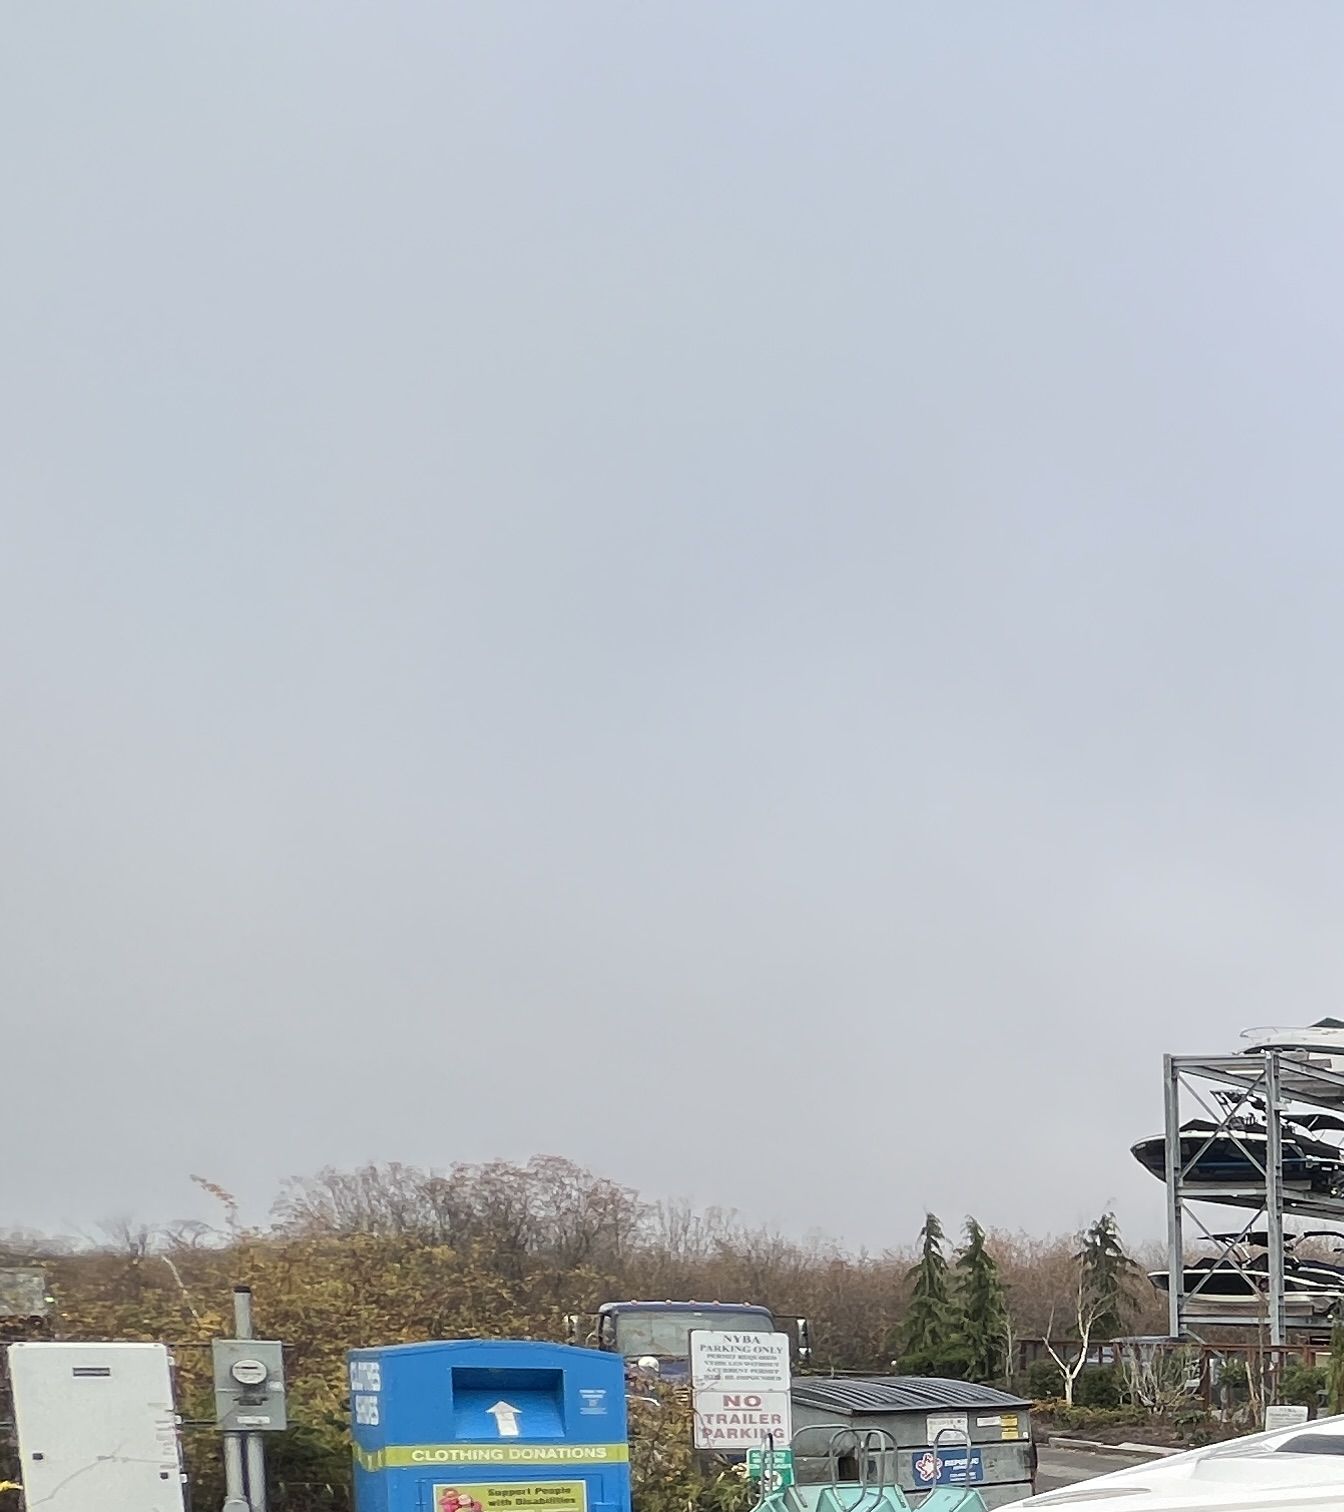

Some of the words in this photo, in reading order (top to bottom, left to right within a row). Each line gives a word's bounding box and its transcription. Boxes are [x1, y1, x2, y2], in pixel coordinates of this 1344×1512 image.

[724, 1335, 761, 1344] NYBA
[700, 1344, 751, 1353] PARKING
[753, 1346, 783, 1354] ONLY
[723, 1394, 762, 1407] NO
[703, 1413, 782, 1424] TRAILER
[703, 1427, 784, 1439] PARKING
[411, 1448, 504, 1462] CLOTHING
[509, 1446, 607, 1460] DONATIONS
[488, 1488, 531, 1497] Support
[535, 1486, 571, 1496] People
[488, 1499, 512, 1507] with
[515, 1496, 576, 1506] Disabilities
